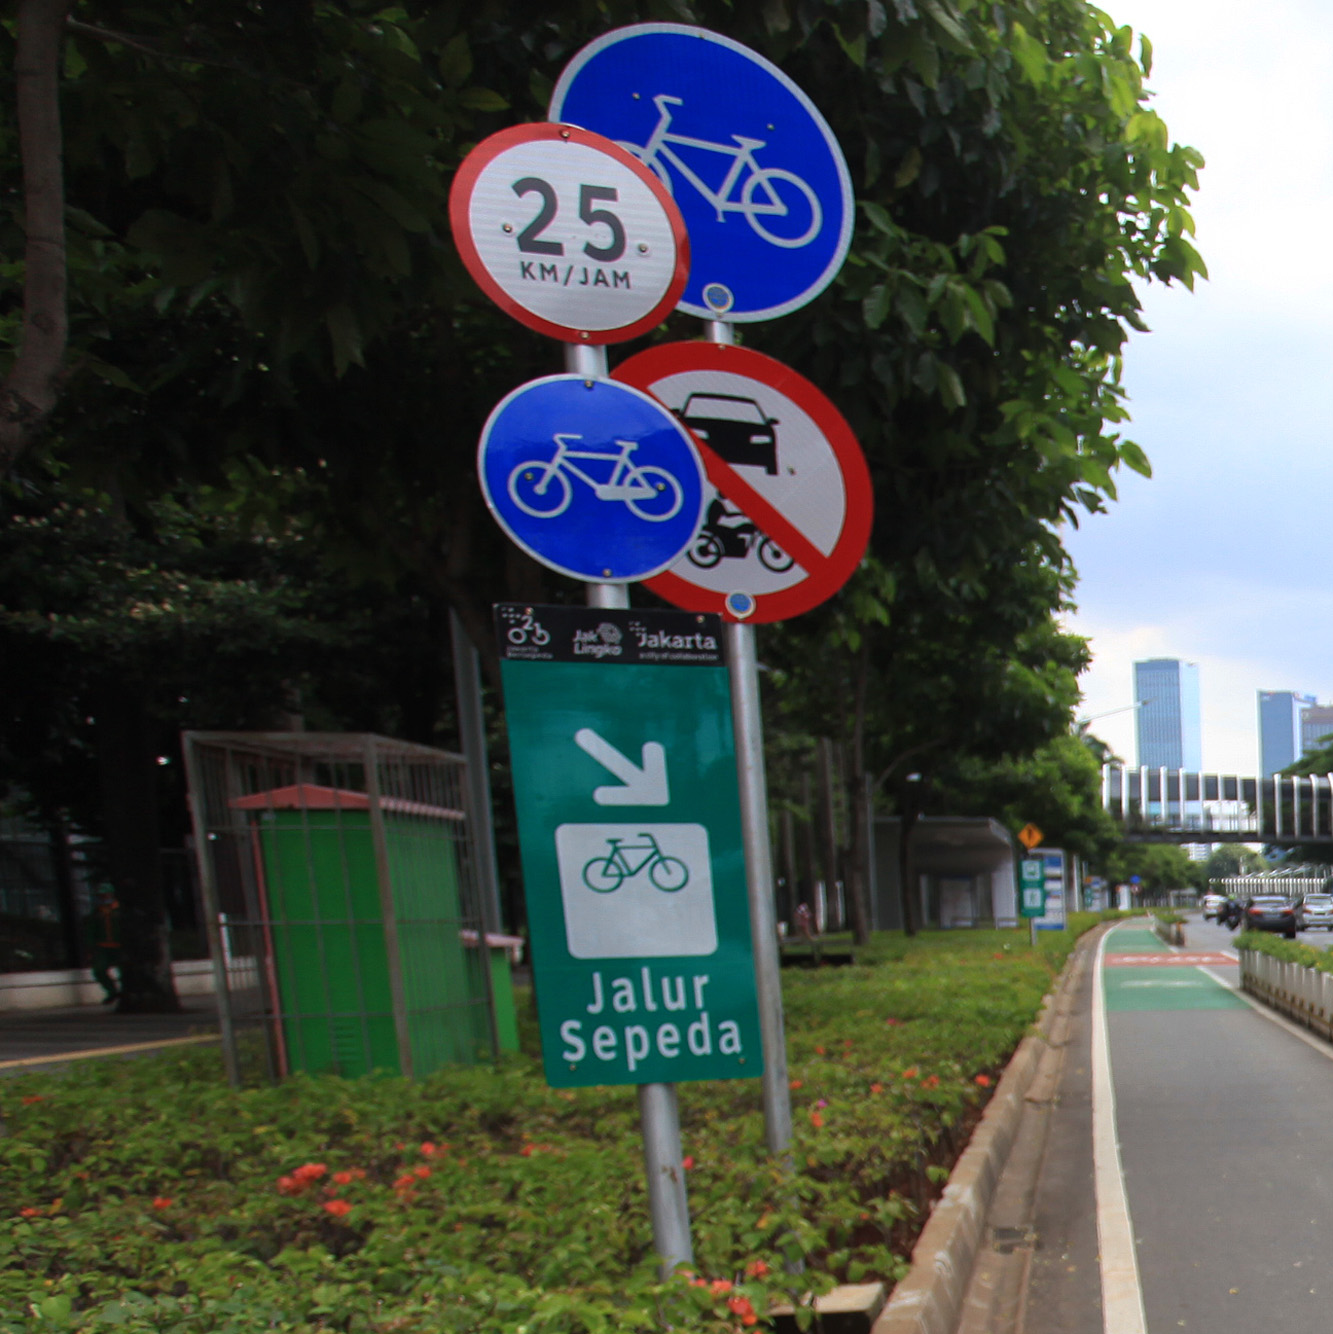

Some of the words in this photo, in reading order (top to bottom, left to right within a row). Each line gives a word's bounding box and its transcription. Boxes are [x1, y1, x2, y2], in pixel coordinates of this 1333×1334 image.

[511, 176, 627, 263] 25
[520, 260, 631, 289] KM/JAM
[572, 629, 599, 643] Jak
[638, 630, 718, 650] Jakarta
[573, 643, 624, 659] Lingko
[587, 966, 710, 1014] Jalur
[560, 1011, 742, 1072] Sepeda
